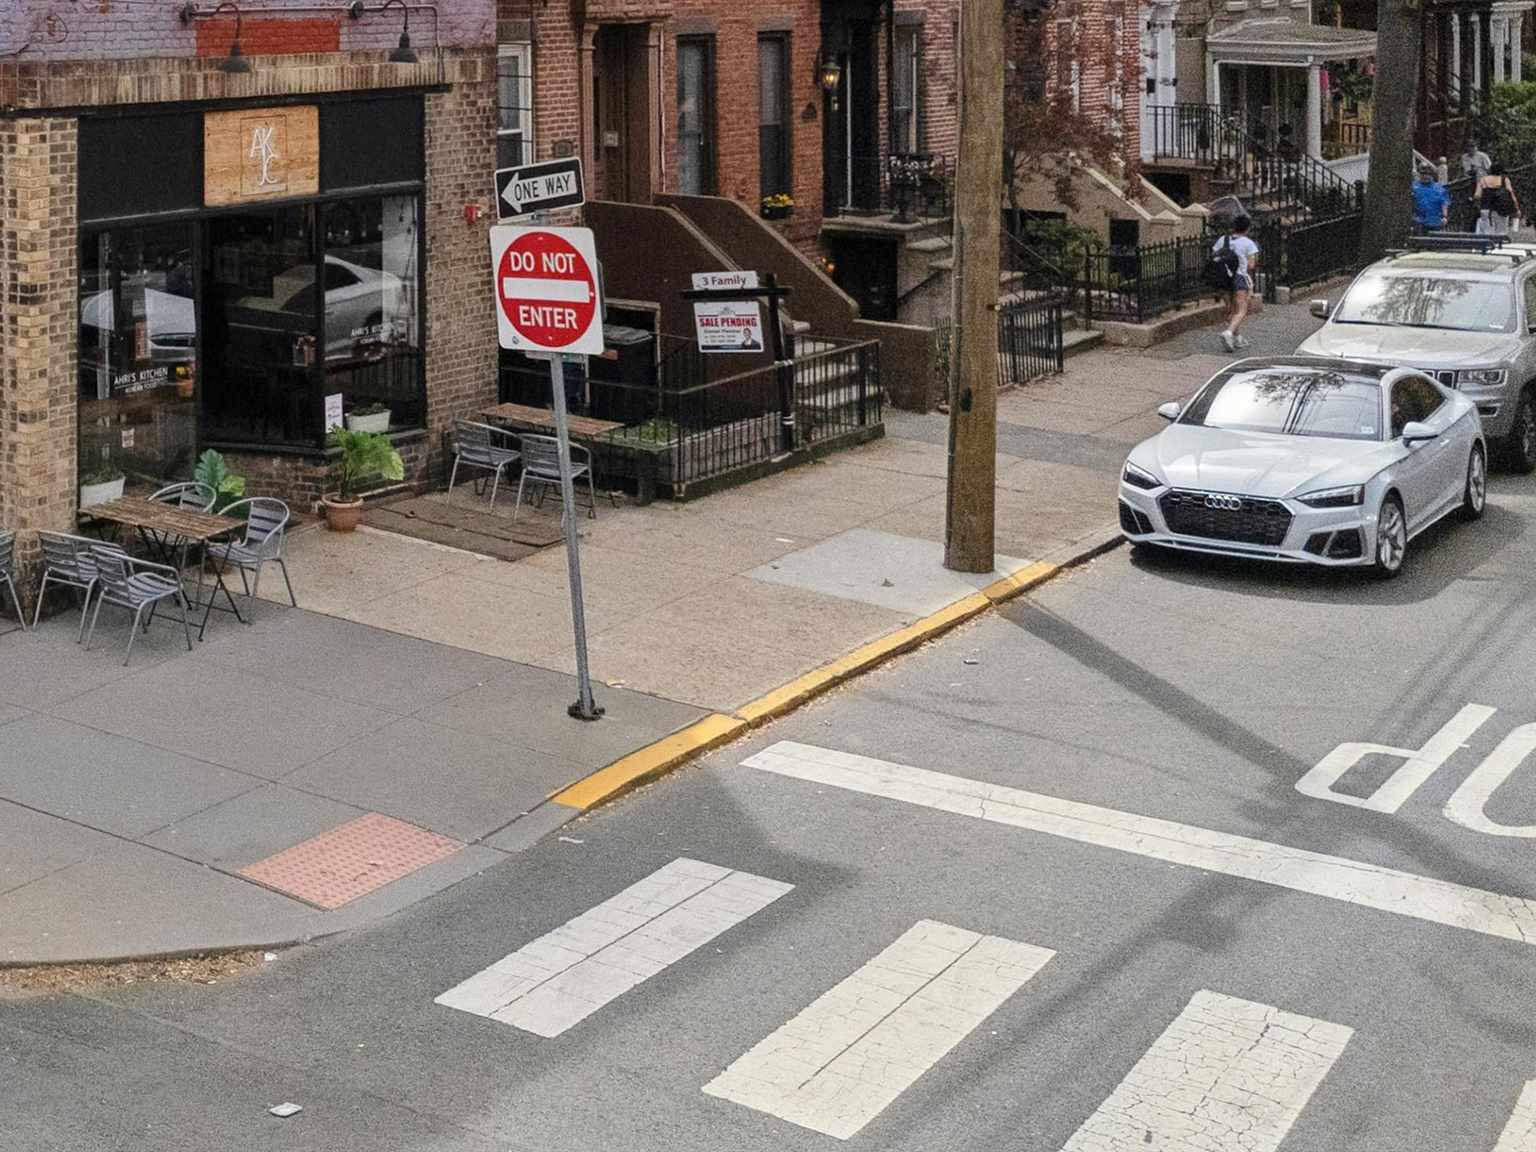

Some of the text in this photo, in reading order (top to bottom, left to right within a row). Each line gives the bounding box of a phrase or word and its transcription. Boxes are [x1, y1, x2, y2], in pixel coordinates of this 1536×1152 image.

[514, 173, 571, 202] ONE WAY
[509, 251, 576, 274] DO NOT
[702, 274, 746, 289] 3 Family
[519, 305, 578, 330] ENTER
[699, 317, 757, 327] SALE PENDING
[139, 367, 169, 380] KITCHEN
